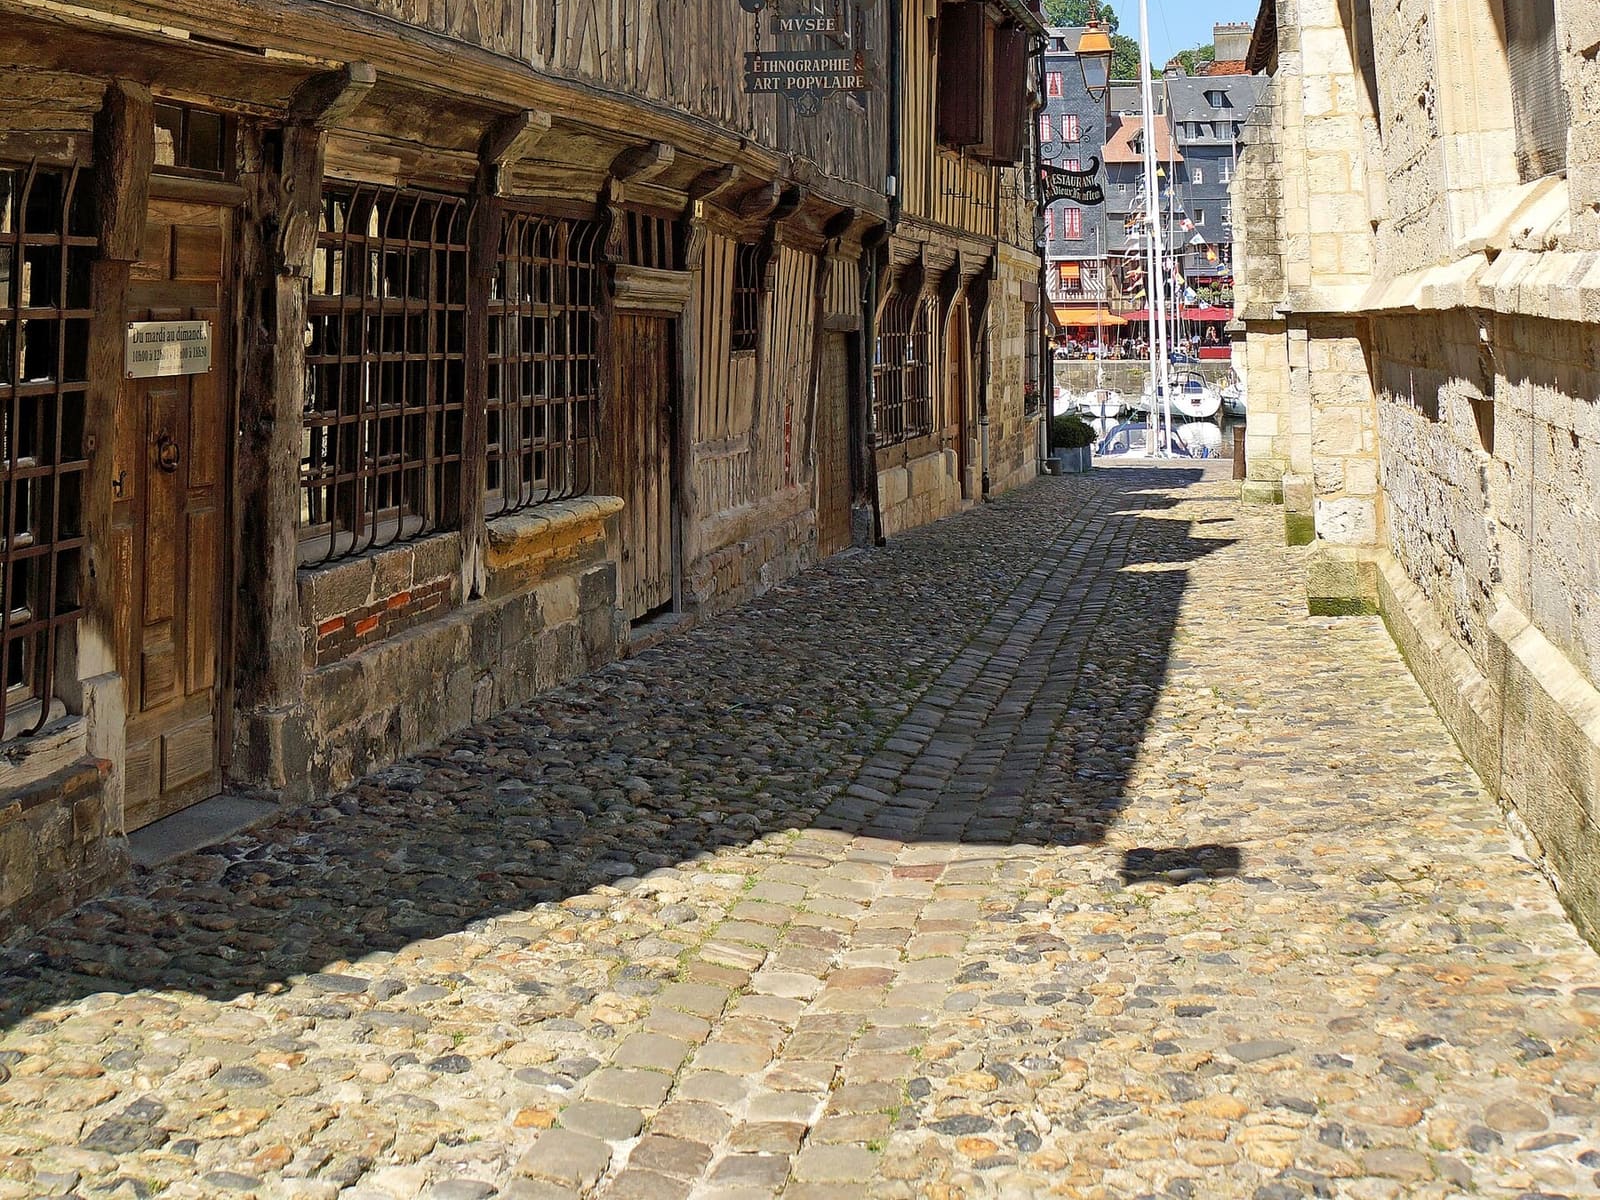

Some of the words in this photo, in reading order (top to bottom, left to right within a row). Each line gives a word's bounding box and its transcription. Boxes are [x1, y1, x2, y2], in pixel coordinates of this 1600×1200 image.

[754, 78, 780, 90] ART
[786, 76, 864, 90] POPVLAIRE
[1046, 174, 1095, 188] RESTAURANT
[133, 328, 143, 343] Du
[145, 327, 165, 342] mardi
[167, 331, 174, 341] au
[176, 325, 207, 340] dimanch
